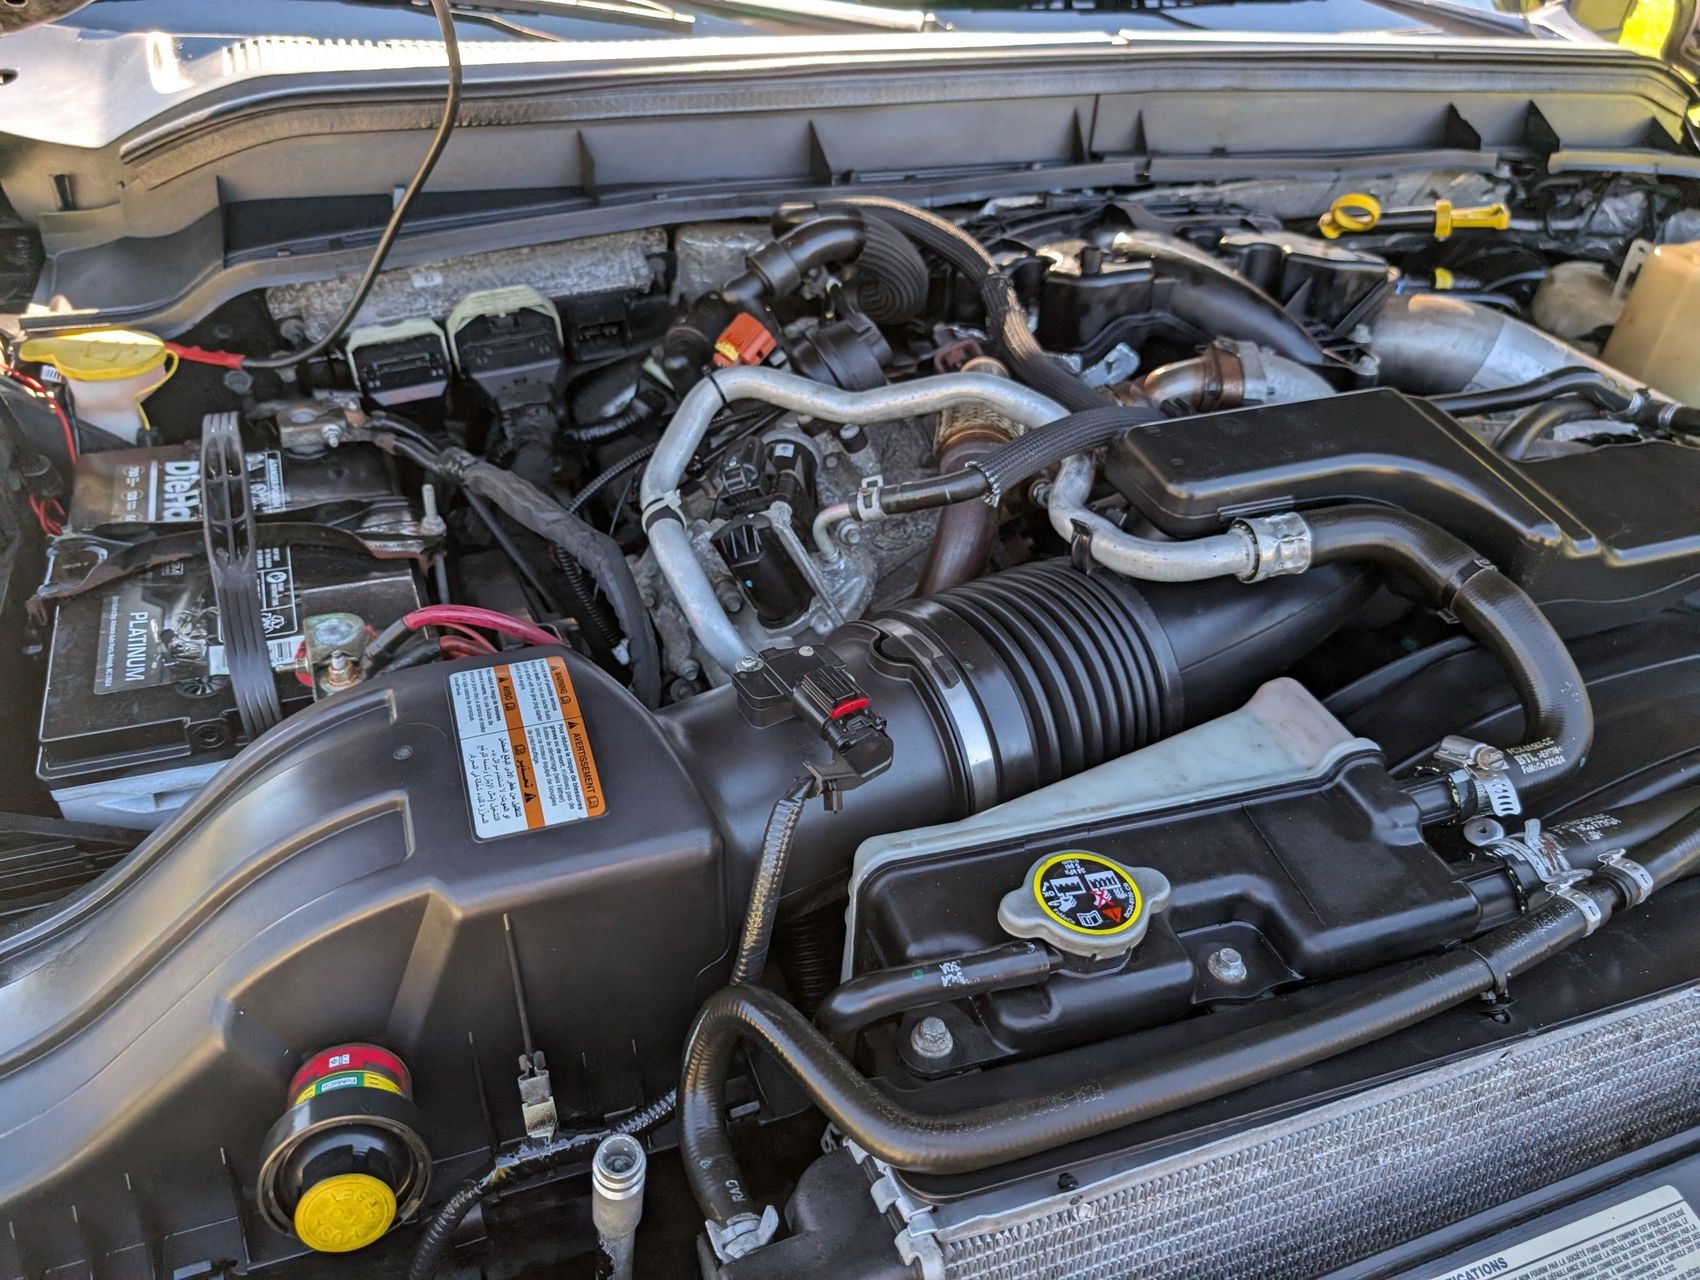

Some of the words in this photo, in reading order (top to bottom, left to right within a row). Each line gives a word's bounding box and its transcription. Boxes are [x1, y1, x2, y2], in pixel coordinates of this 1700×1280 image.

[162, 460, 200, 522] DieHa
[123, 610, 150, 682] PLATINUM
[501, 684, 512, 700] AVISO
[548, 724, 558, 740] graves
[557, 723, 565, 734] Pour
[571, 782, 584, 810] blessures
[572, 732, 596, 794] AVERTISSEMENT
[1520, 760, 1546, 774] FoMoCo
[545, 785, 557, 807] bougies
[565, 790, 573, 801] pas
[568, 801, 576, 809] de
[322, 1078, 357, 1090] FoMoCo
[1547, 1260, 1559, 1270] PAR
[1557, 1257, 1567, 1266] LA
[1564, 1248, 1587, 1263] SOCIÉTÉ
[1585, 1243, 1600, 1254] FORD
[1614, 1227, 1639, 1242] COMPANY
[1637, 1223, 1648, 1232] EST
[1646, 1217, 1661, 1229] POSÉ
[1601, 1249, 1610, 1258] LA
[1608, 1236, 1641, 1255] DÉFAILLANCE
[1627, 1244, 1648, 1257] SERONT
[1646, 1240, 1658, 1250] PAS
[1679, 1226, 1690, 1235] PAR
